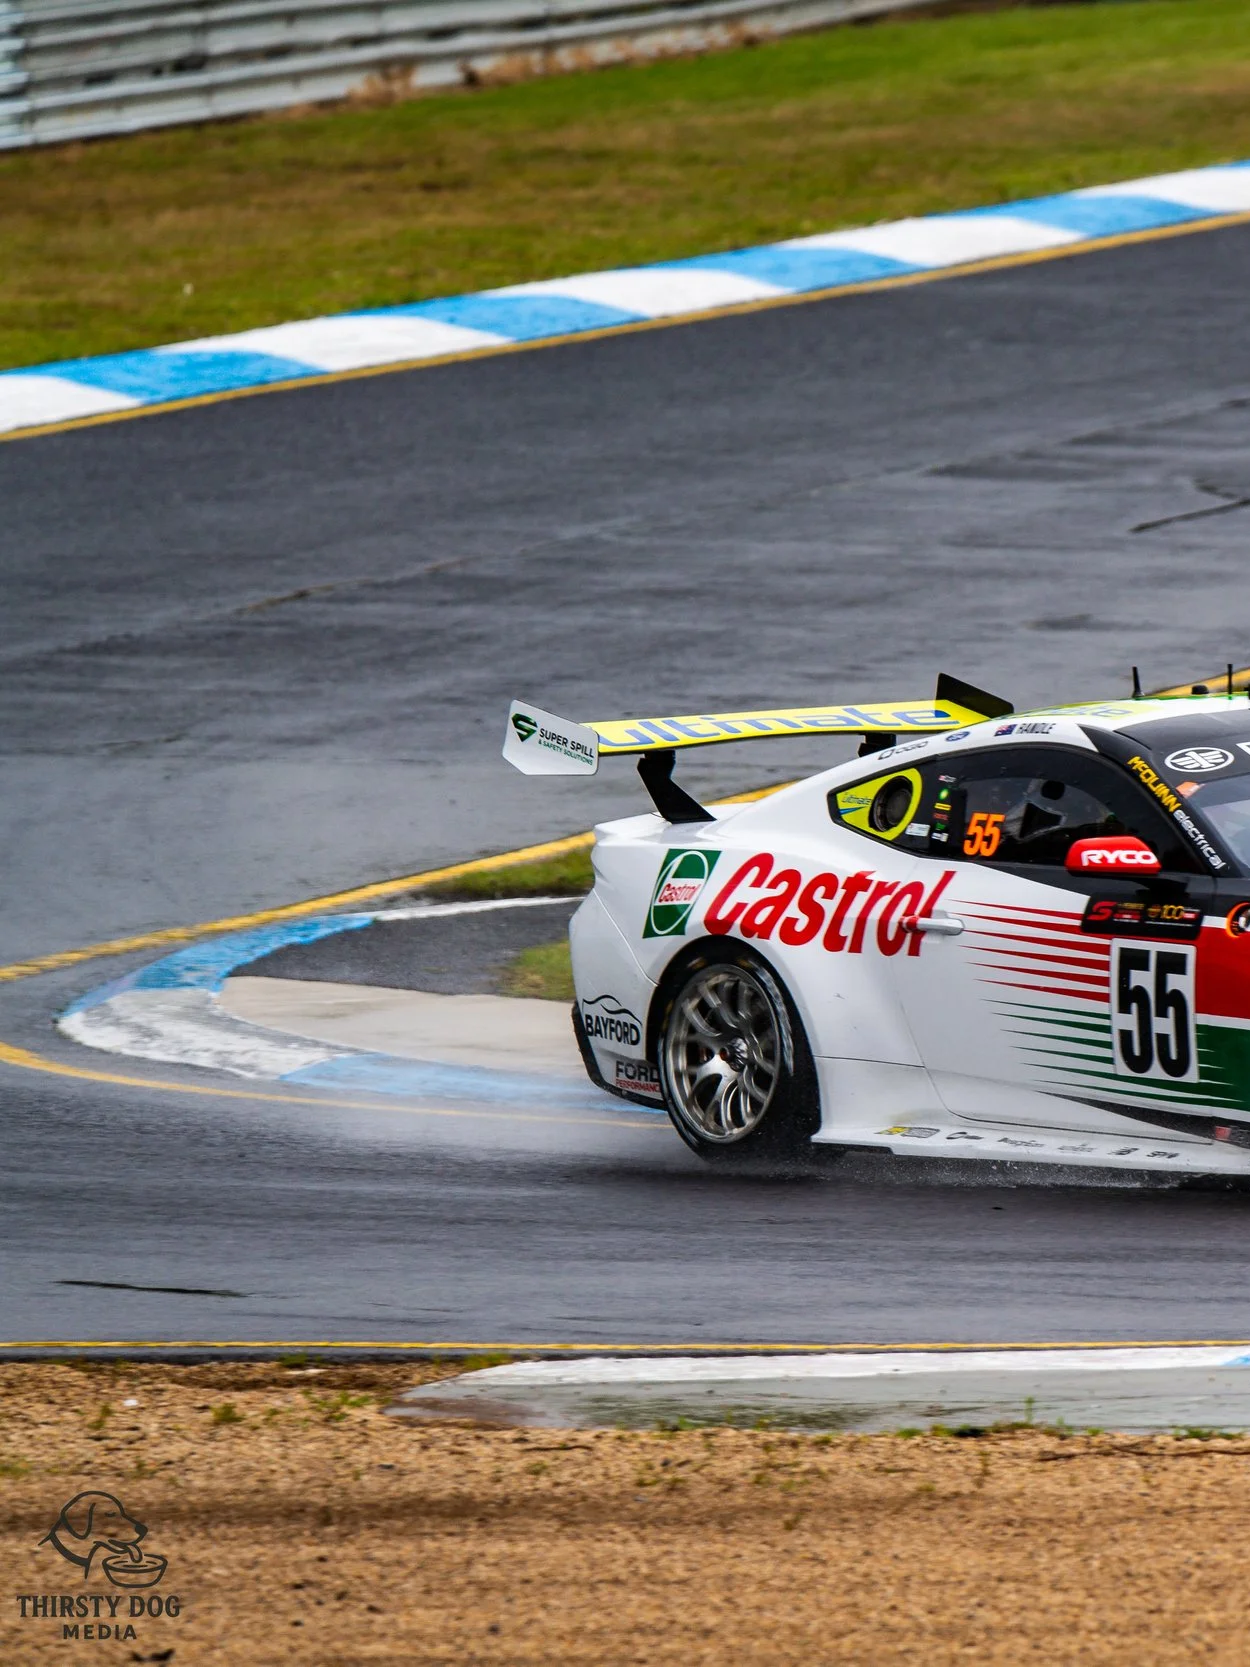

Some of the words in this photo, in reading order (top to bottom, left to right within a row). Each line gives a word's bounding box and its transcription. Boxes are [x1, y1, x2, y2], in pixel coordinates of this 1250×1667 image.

[599, 707, 960, 747] ultimate
[539, 728, 569, 748] SUPER
[570, 740, 594, 758] SPILL
[543, 740, 562, 753] SAFETY
[563, 749, 593, 766] SOLUTIONS
[963, 812, 1006, 857] 55
[1173, 809, 1227, 870] electrical
[1081, 850, 1158, 867] RYCO
[658, 883, 701, 903] Castrol
[703, 852, 957, 957] Castrol
[1117, 946, 1191, 1078] 55
[585, 1013, 641, 1046] BAYFORD
[615, 1060, 660, 1082] FORD
[615, 1078, 660, 1093] PERFORMANC
